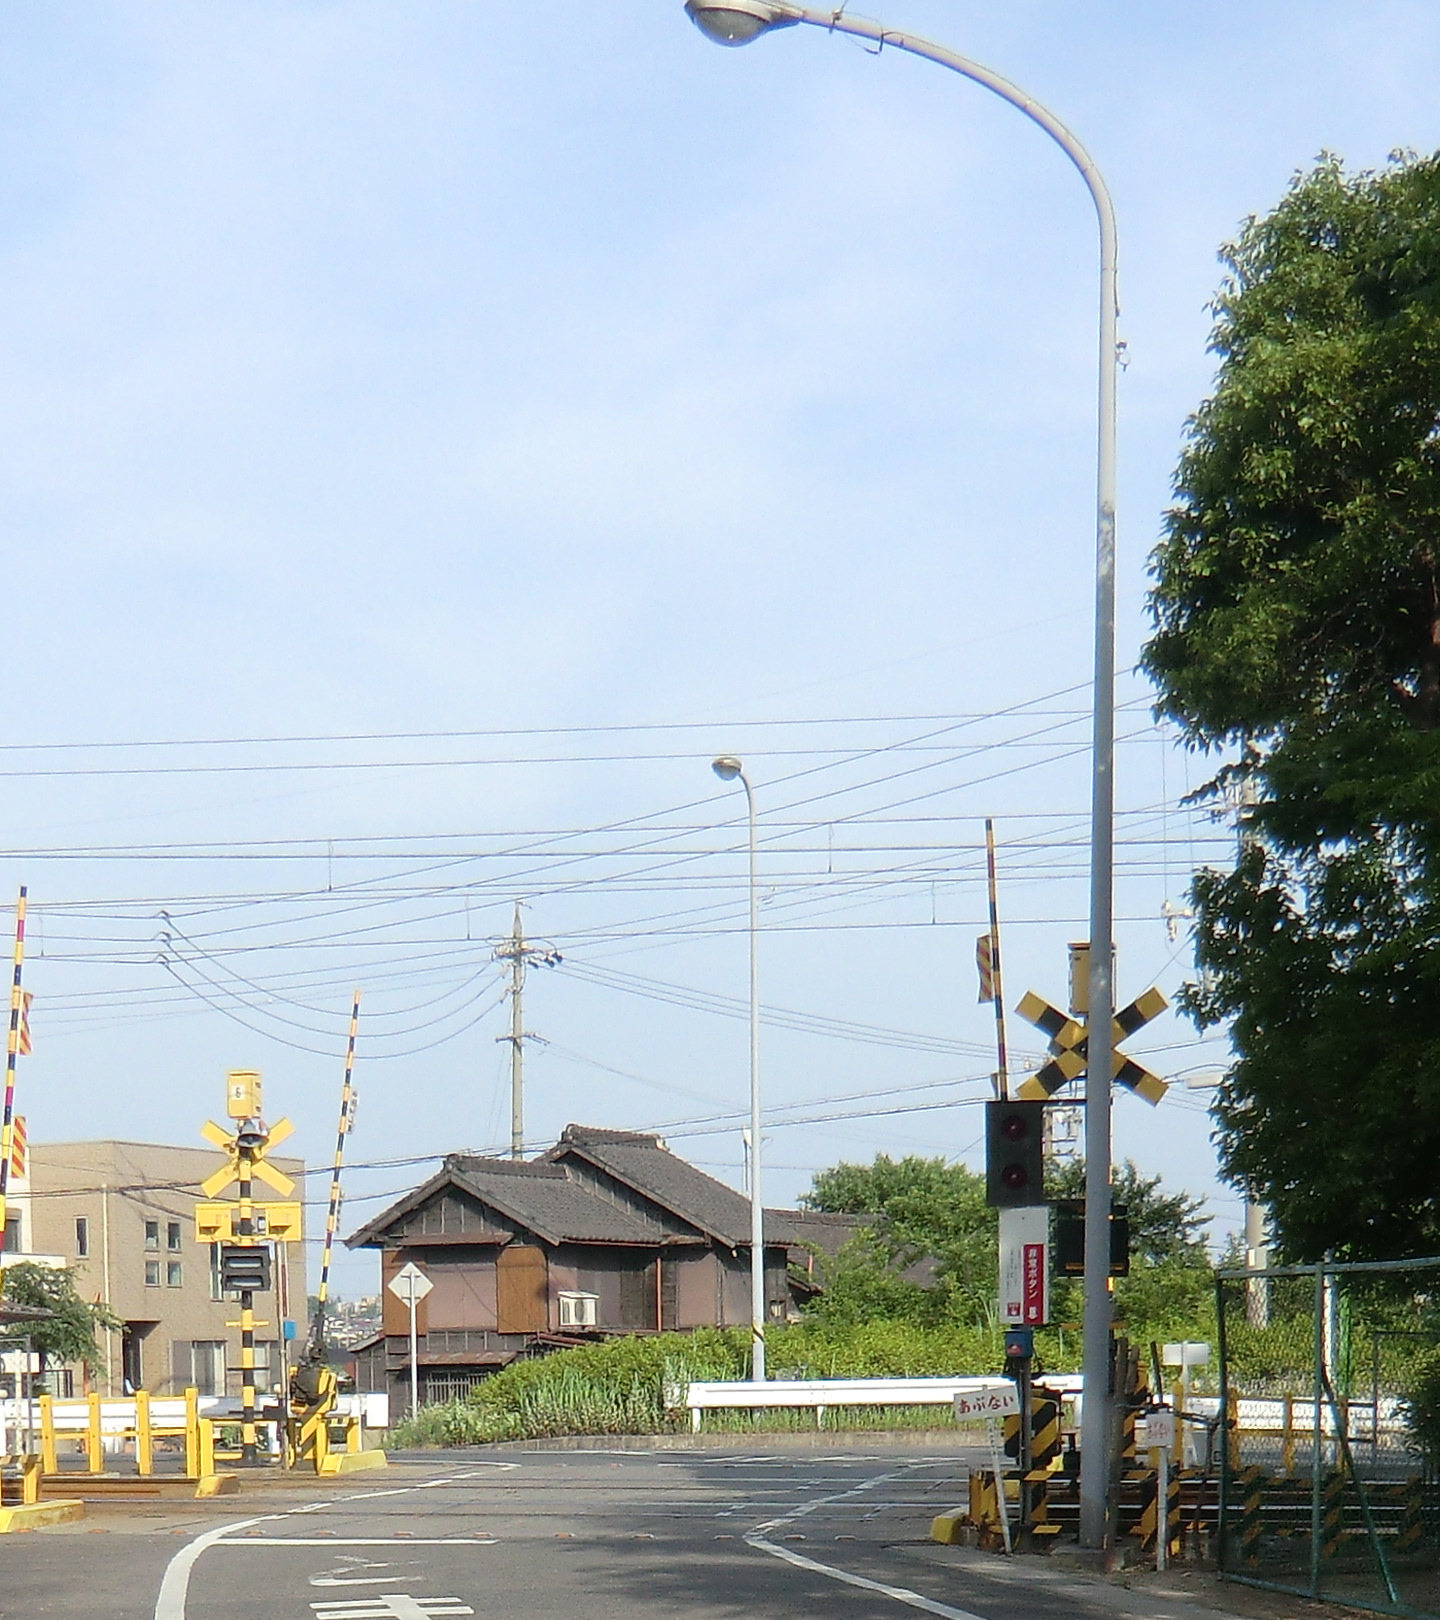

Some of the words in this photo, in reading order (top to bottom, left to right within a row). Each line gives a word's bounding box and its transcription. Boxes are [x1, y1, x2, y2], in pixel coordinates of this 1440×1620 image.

[1027, 1248, 1039, 1300] 非常ボタン
[959, 1395, 1014, 1414] あぶない
